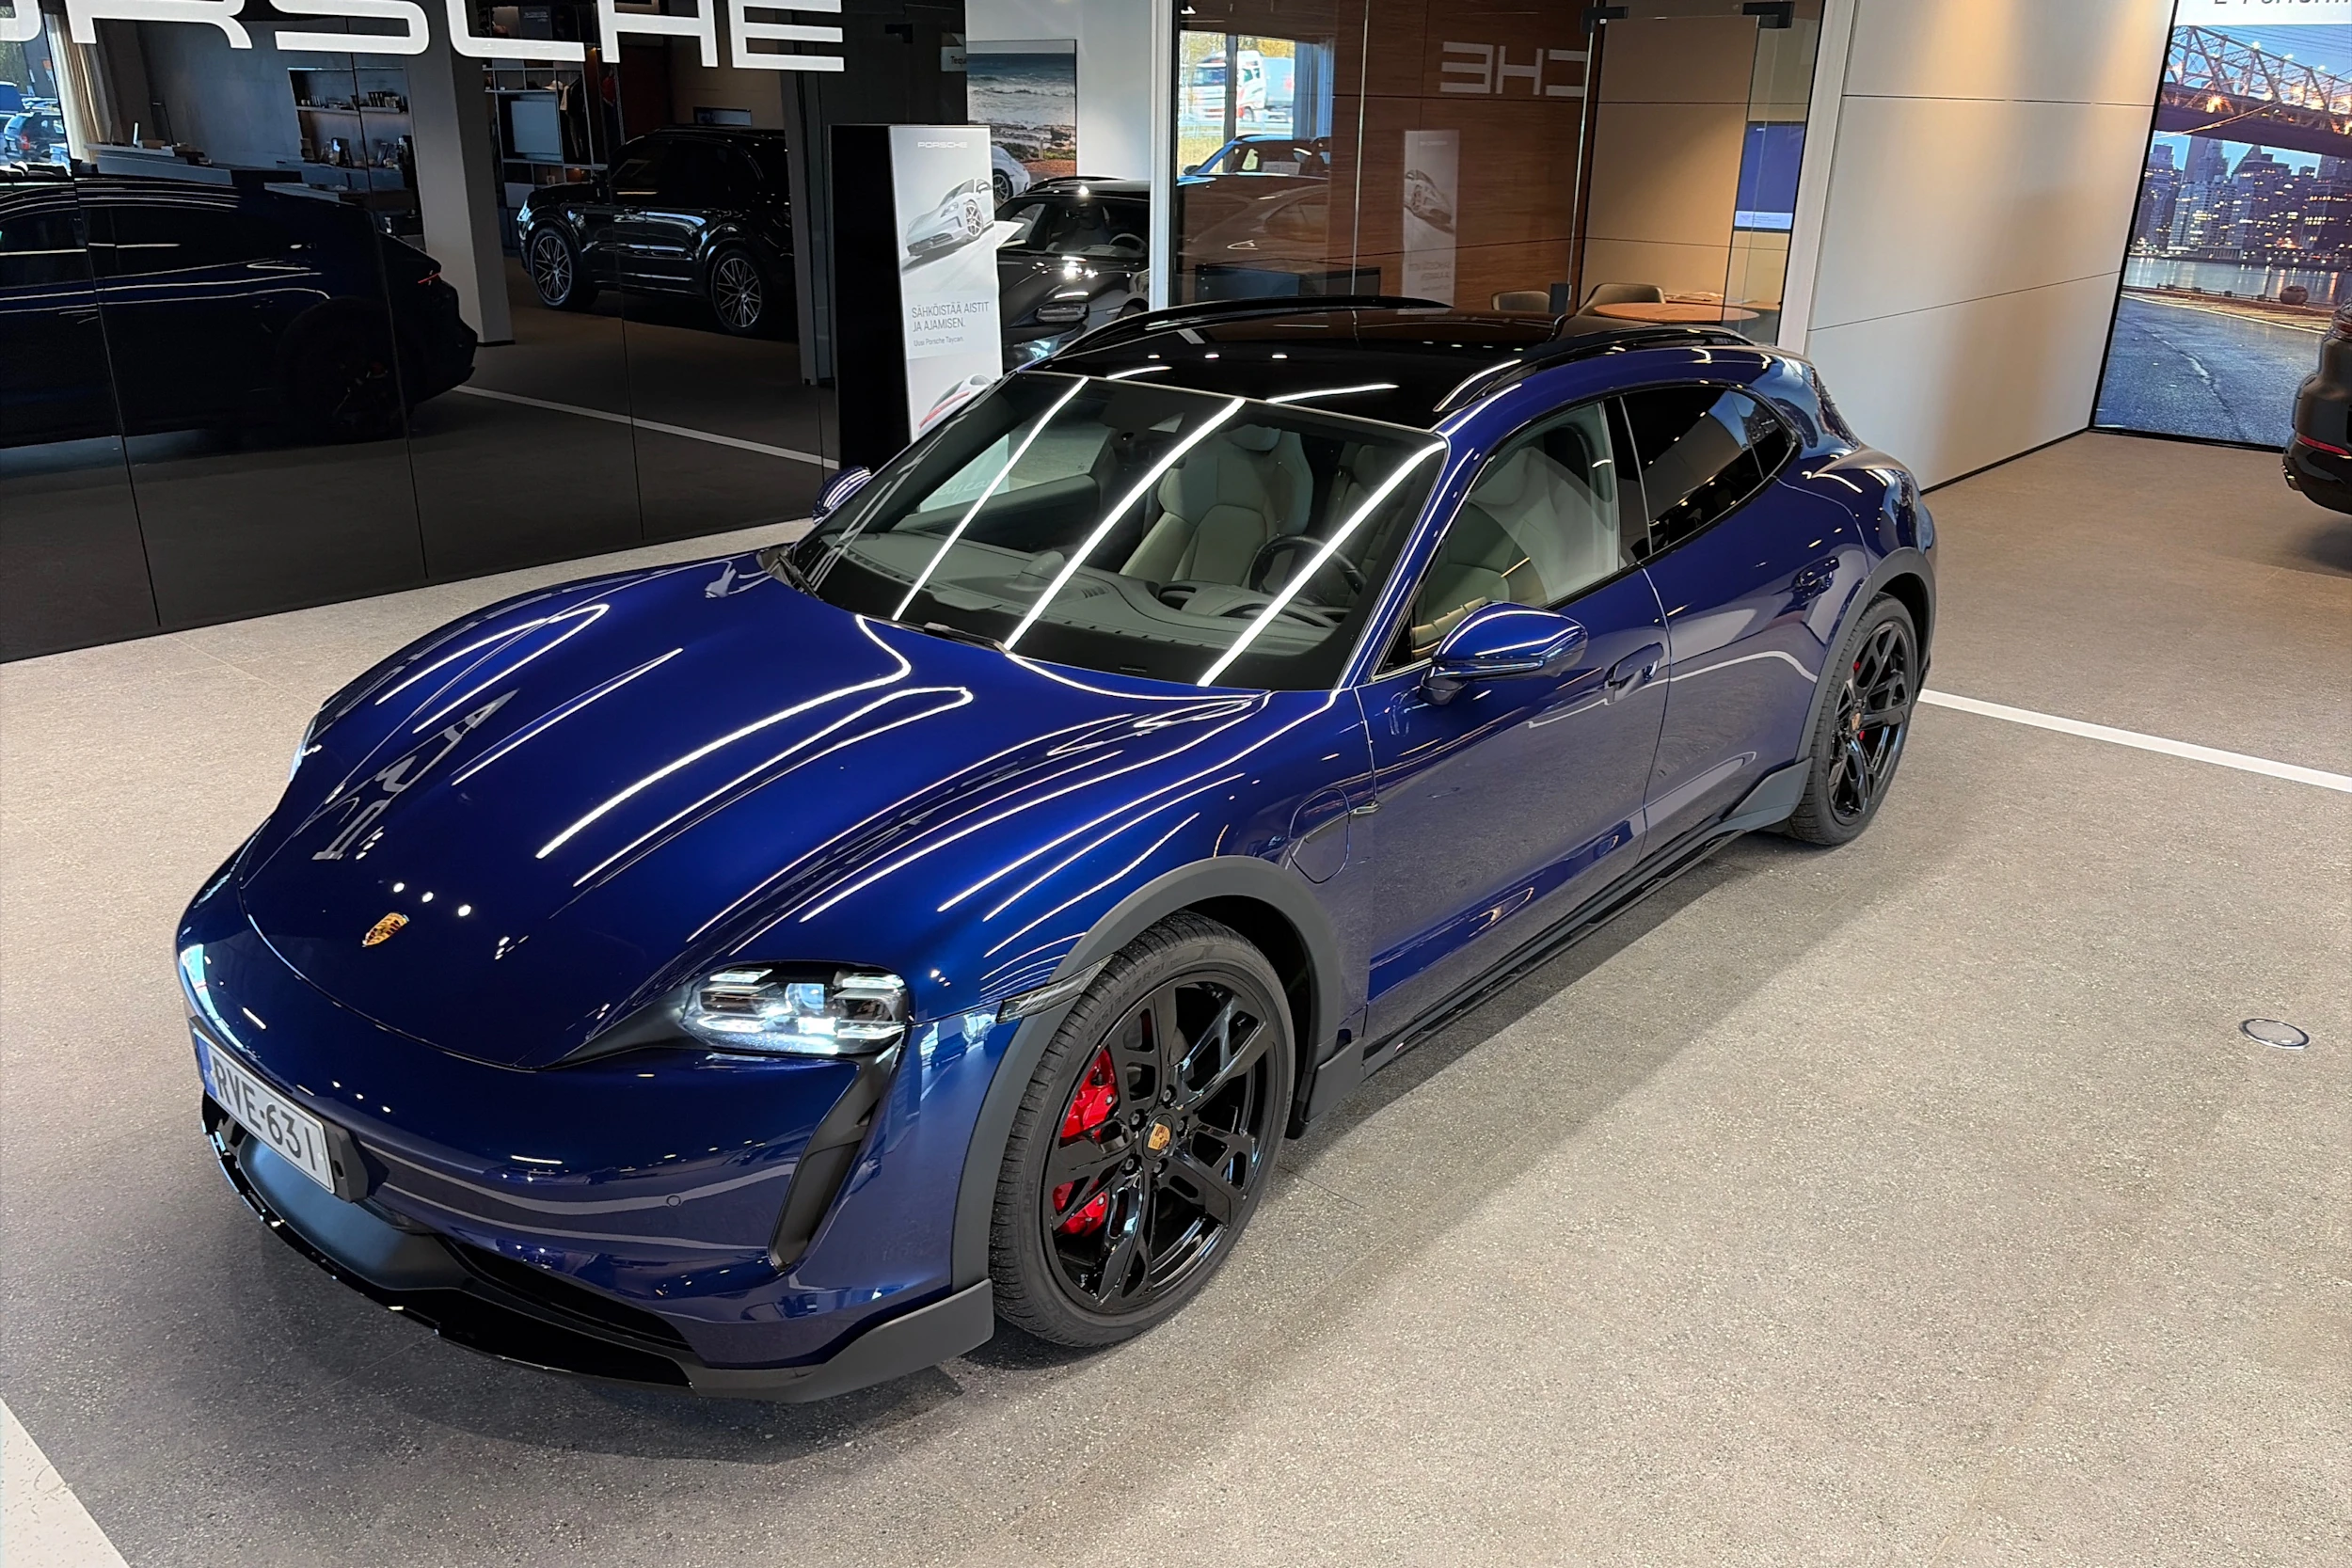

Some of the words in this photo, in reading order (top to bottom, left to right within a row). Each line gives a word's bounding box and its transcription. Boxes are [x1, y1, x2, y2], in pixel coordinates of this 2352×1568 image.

[912, 302, 961, 318] SÄHKÖISTÄÄ
[964, 302, 989, 313] AISTIT
[913, 321, 922, 332] JA
[924, 318, 965, 330] AJAMISEN.
[926, 337, 946, 345] Porsche
